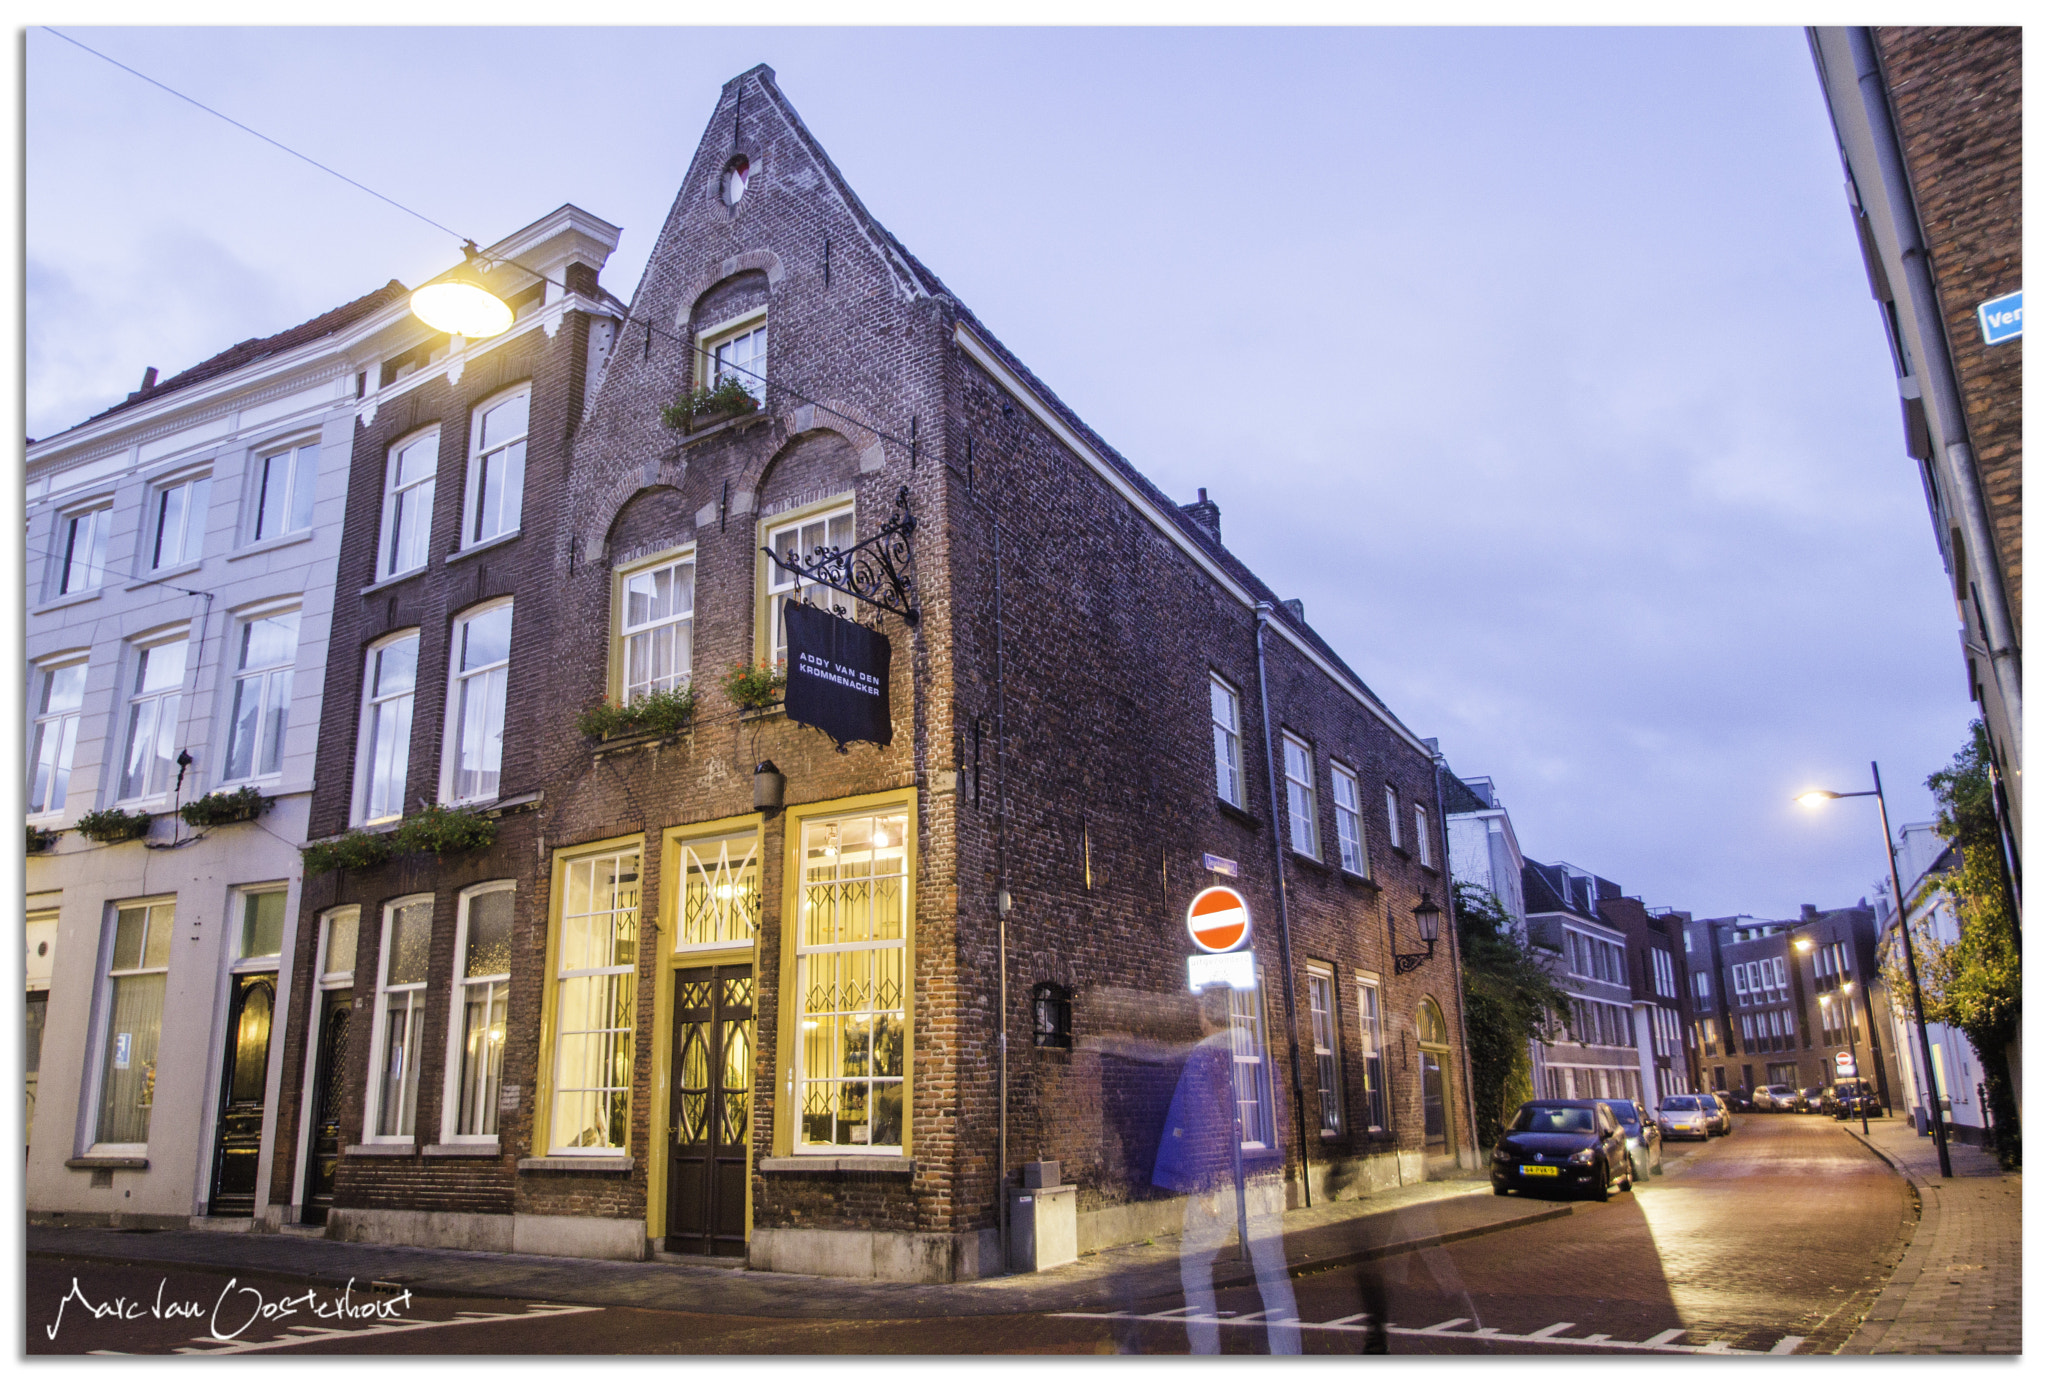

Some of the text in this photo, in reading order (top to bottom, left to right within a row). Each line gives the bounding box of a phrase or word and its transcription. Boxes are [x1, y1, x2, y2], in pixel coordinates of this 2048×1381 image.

[800, 652, 880, 686] ADDY VAN DEN
[800, 663, 880, 697] KROMMENACKER
